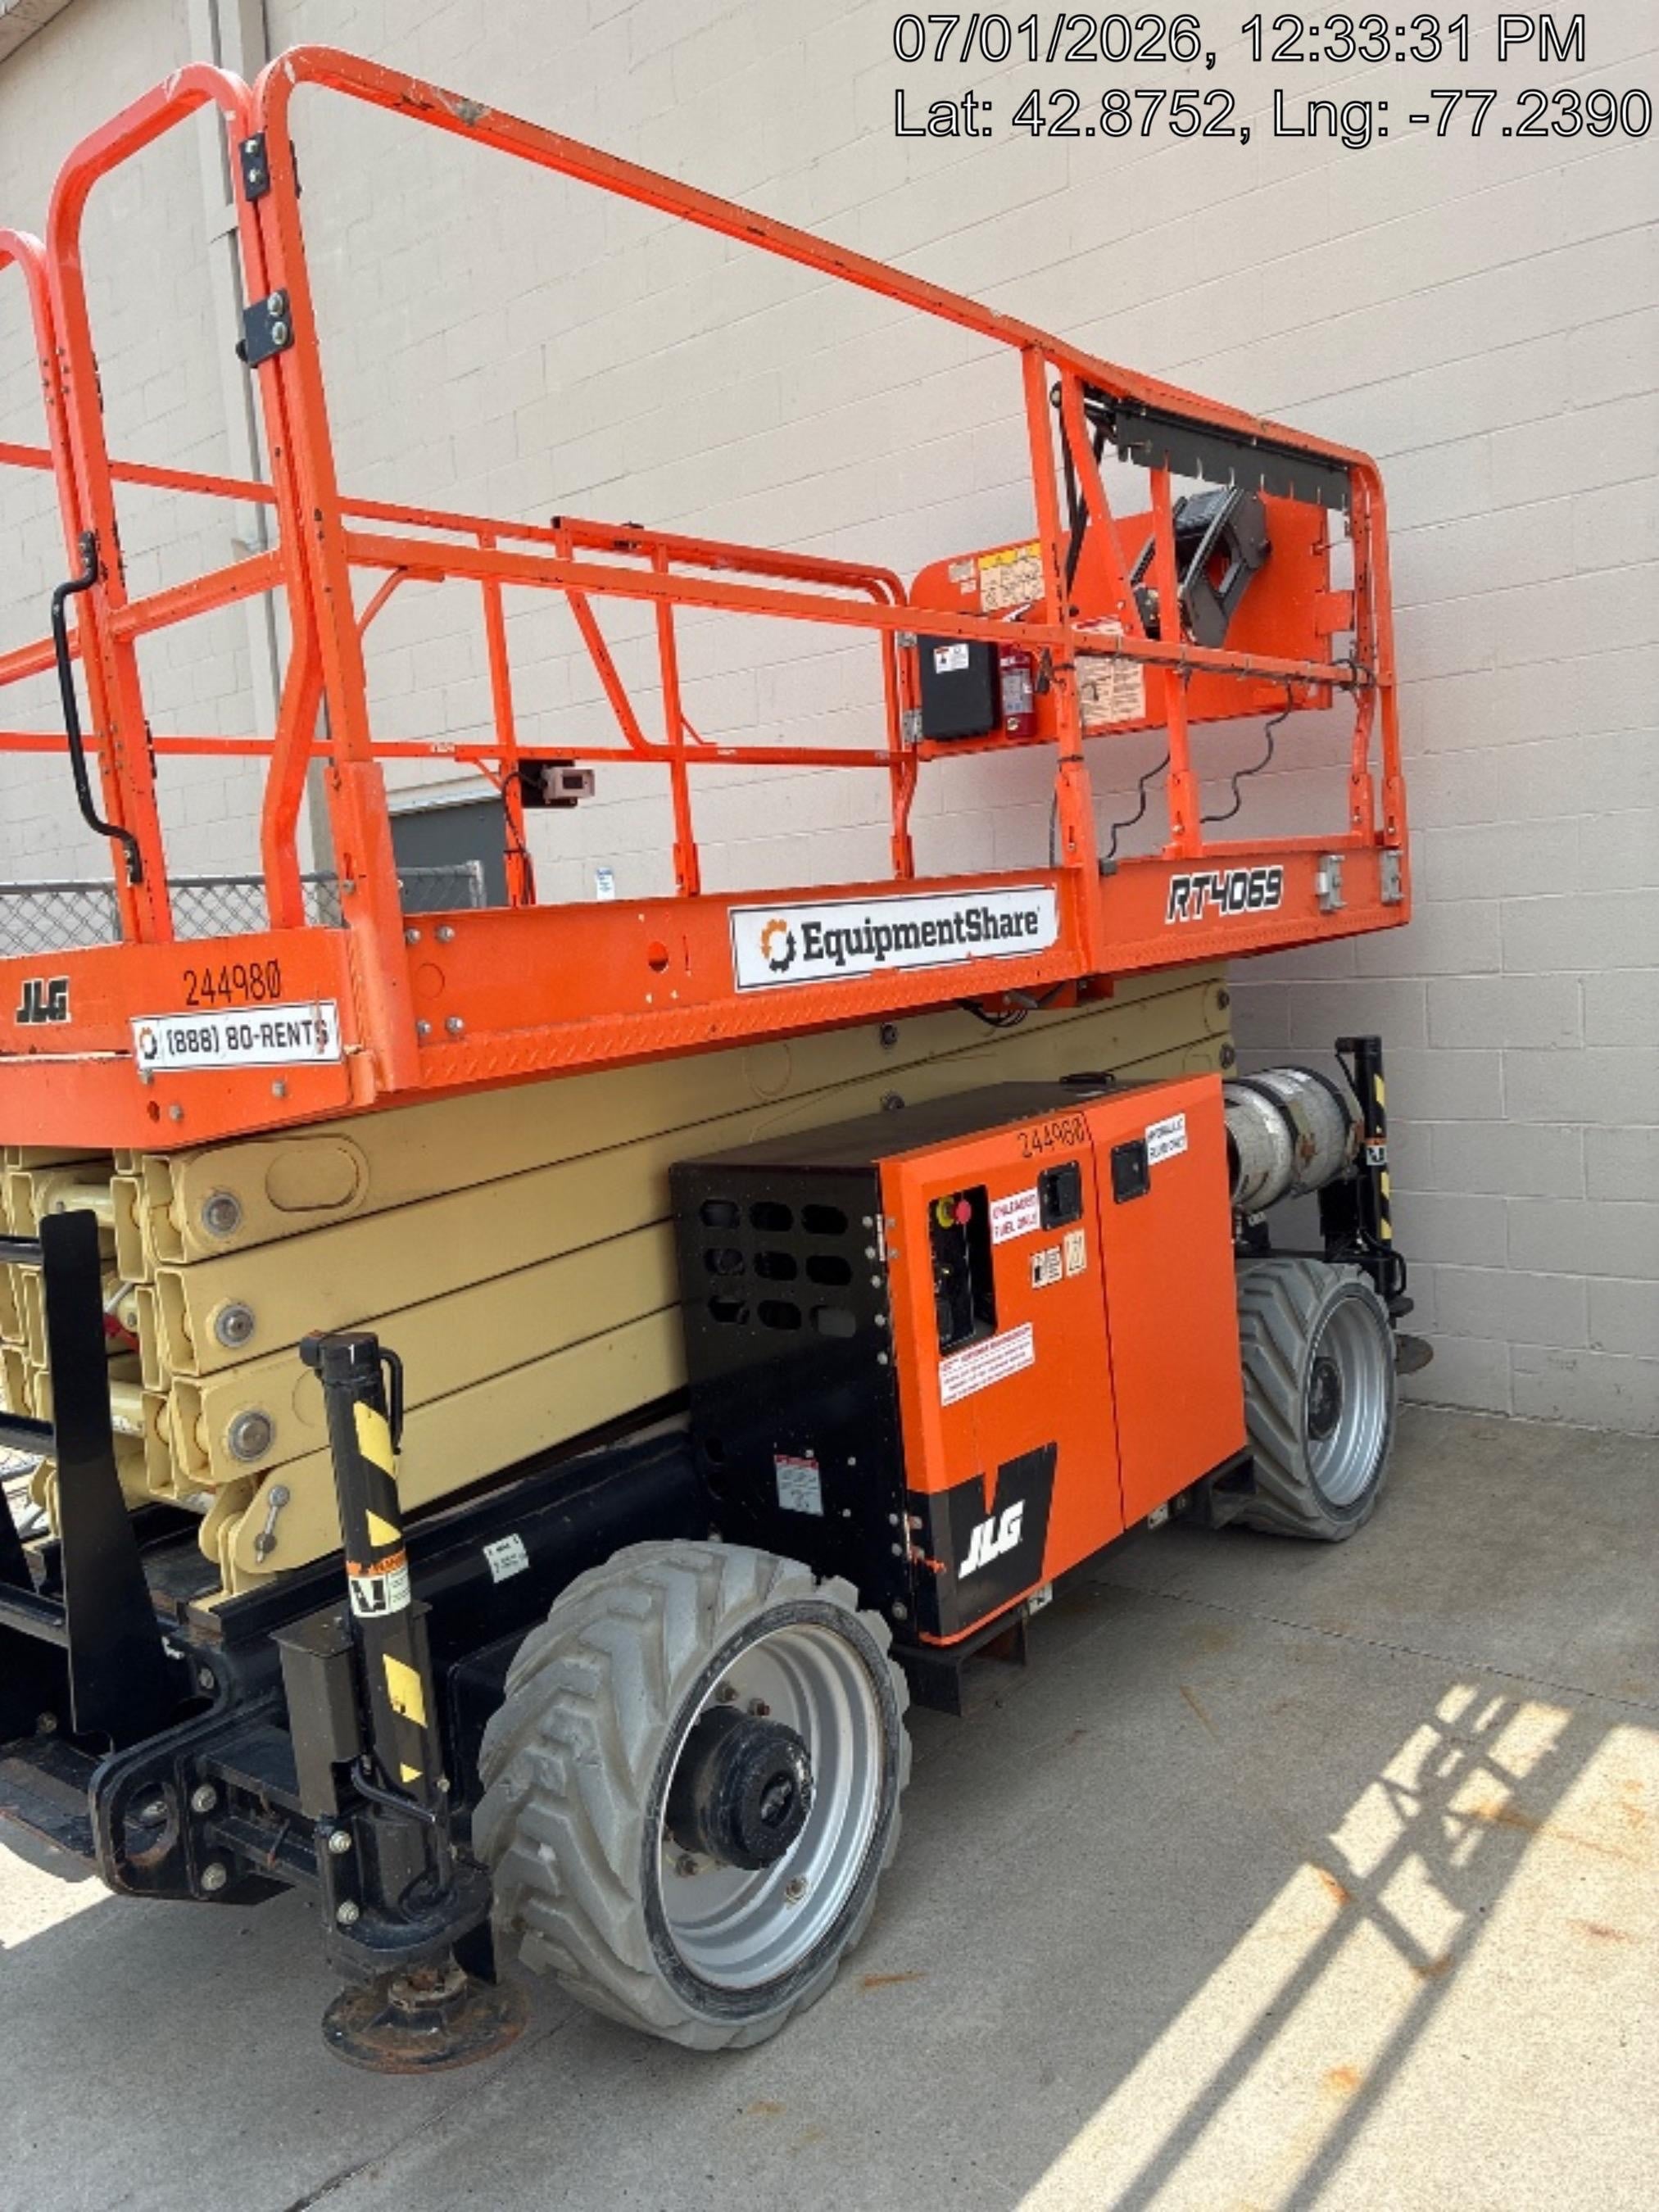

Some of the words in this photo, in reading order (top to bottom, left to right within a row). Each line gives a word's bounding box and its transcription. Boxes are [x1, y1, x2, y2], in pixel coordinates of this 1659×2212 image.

[1166, 866, 1283, 922] RT4069
[800, 905, 1039, 967] EquipmentShare
[16, 977, 70, 1023] JLG
[183, 959, 281, 1006] 244980
[168, 1024, 220, 1054] (888)
[958, 1498, 1026, 1580] JLG
